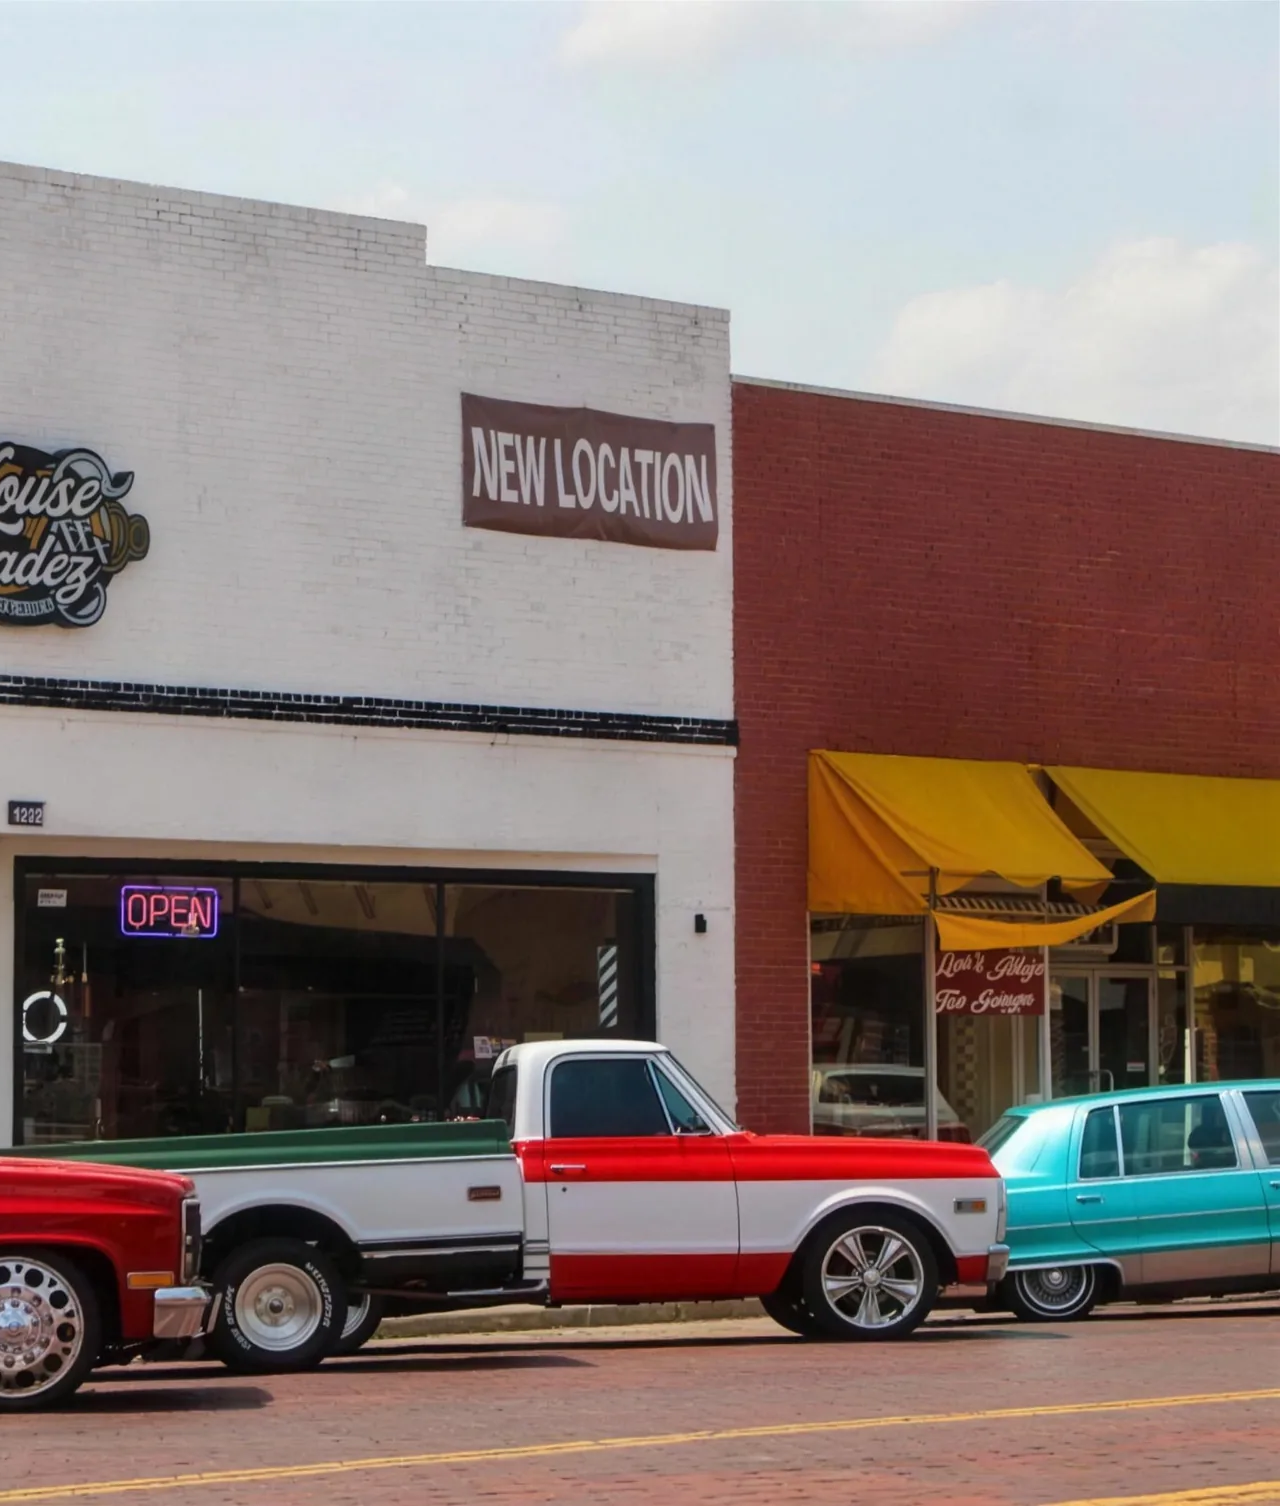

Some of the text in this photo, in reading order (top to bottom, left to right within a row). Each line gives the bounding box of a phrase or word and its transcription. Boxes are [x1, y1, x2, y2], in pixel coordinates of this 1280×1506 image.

[471, 426, 714, 524] NEW LOCATION
[127, 893, 212, 930] OPEN
